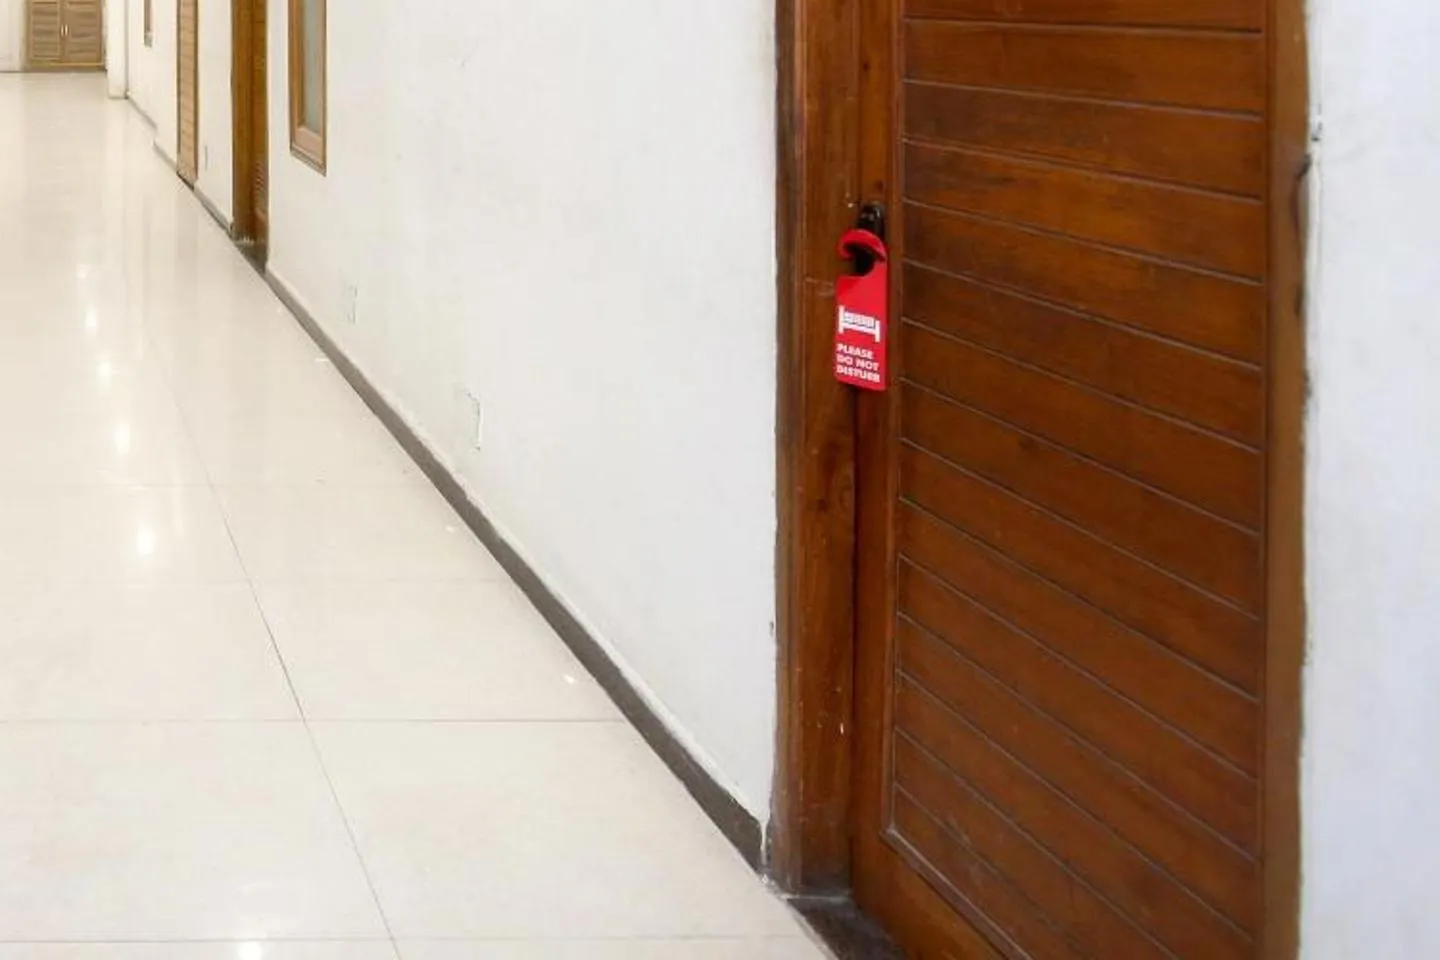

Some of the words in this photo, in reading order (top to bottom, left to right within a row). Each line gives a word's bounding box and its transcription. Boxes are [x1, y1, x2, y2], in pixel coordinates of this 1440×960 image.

[836, 343, 874, 360] PLEASE
[836, 353, 853, 365] DO
[855, 358, 879, 371] NOT
[836, 364, 880, 383] DISTURB
